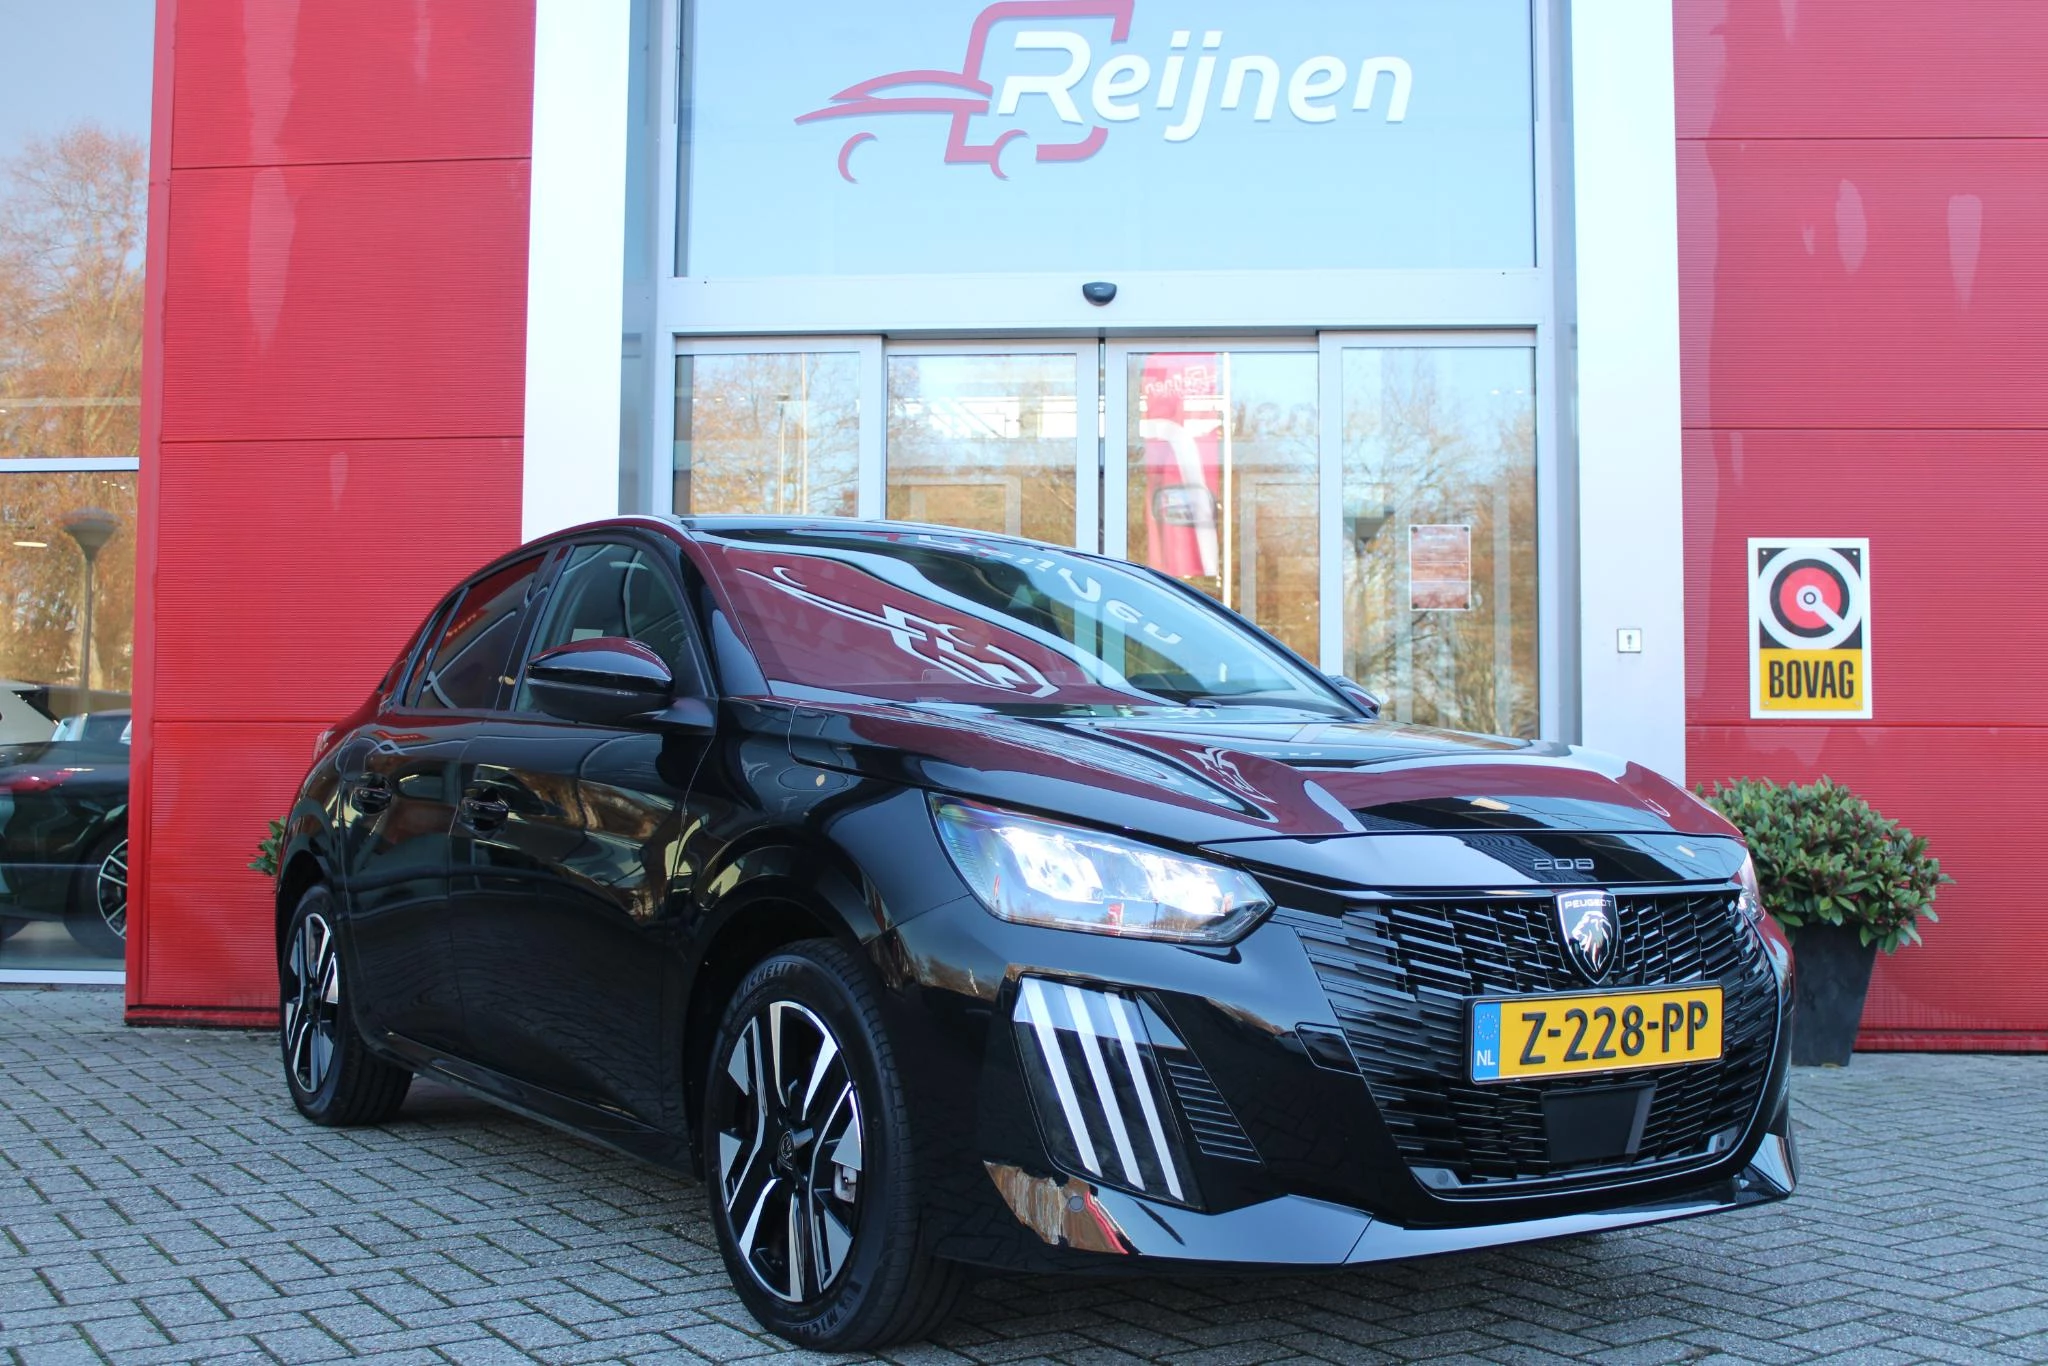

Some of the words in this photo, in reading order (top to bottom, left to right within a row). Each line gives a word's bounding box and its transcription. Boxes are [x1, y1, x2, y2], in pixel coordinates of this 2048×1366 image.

[997, 30, 1413, 142] Reijnen
[1769, 660, 1855, 699] BOVAG
[1532, 858, 1595, 871] 208
[1564, 899, 1612, 909] PEUGEOT
[1519, 1000, 1709, 1066] Z-228-PP
[1476, 1050, 1496, 1067] NL
